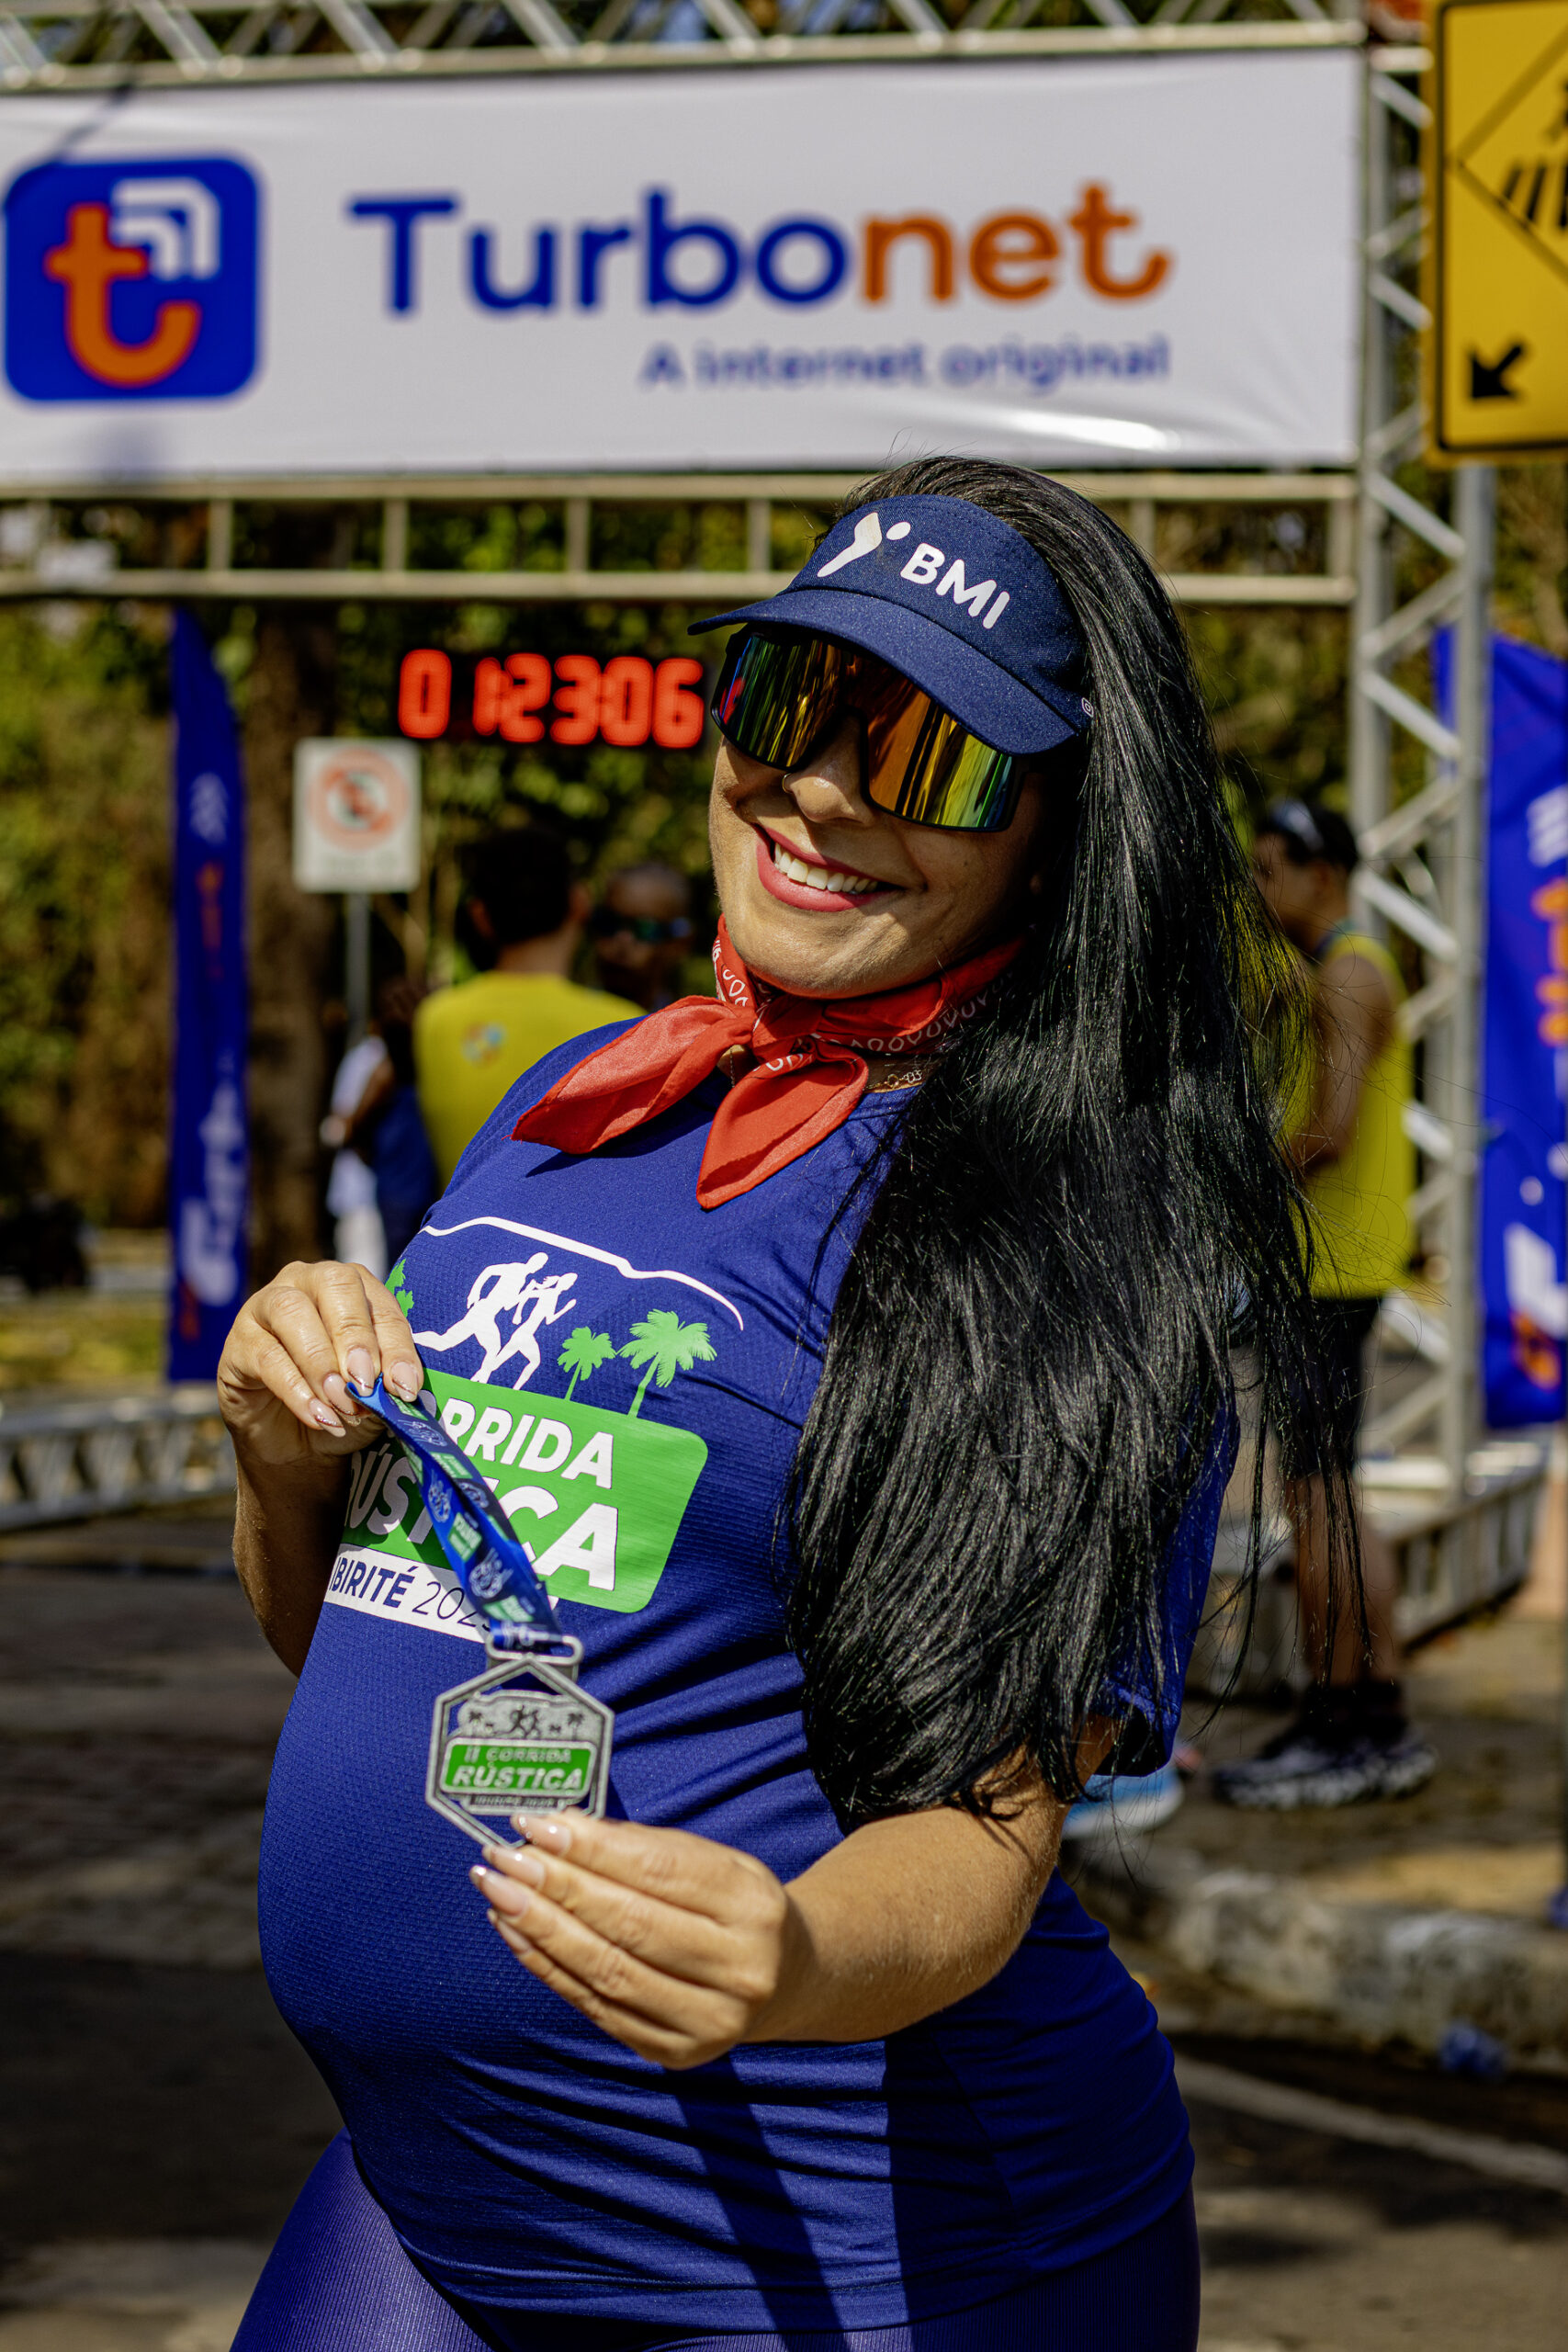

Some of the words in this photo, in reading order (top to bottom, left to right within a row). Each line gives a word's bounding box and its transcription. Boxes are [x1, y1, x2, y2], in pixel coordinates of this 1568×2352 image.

[345, 184, 1172, 315] Turbonet
[640, 342, 684, 390] A
[694, 338, 926, 390] internet
[939, 333, 1169, 395] original
[900, 543, 1010, 628] BMI
[418, 1389, 614, 1489] RRIDA
[452, 1761, 583, 1791] RÚSTICA
[486, 1747, 571, 1762] CORRIDA
